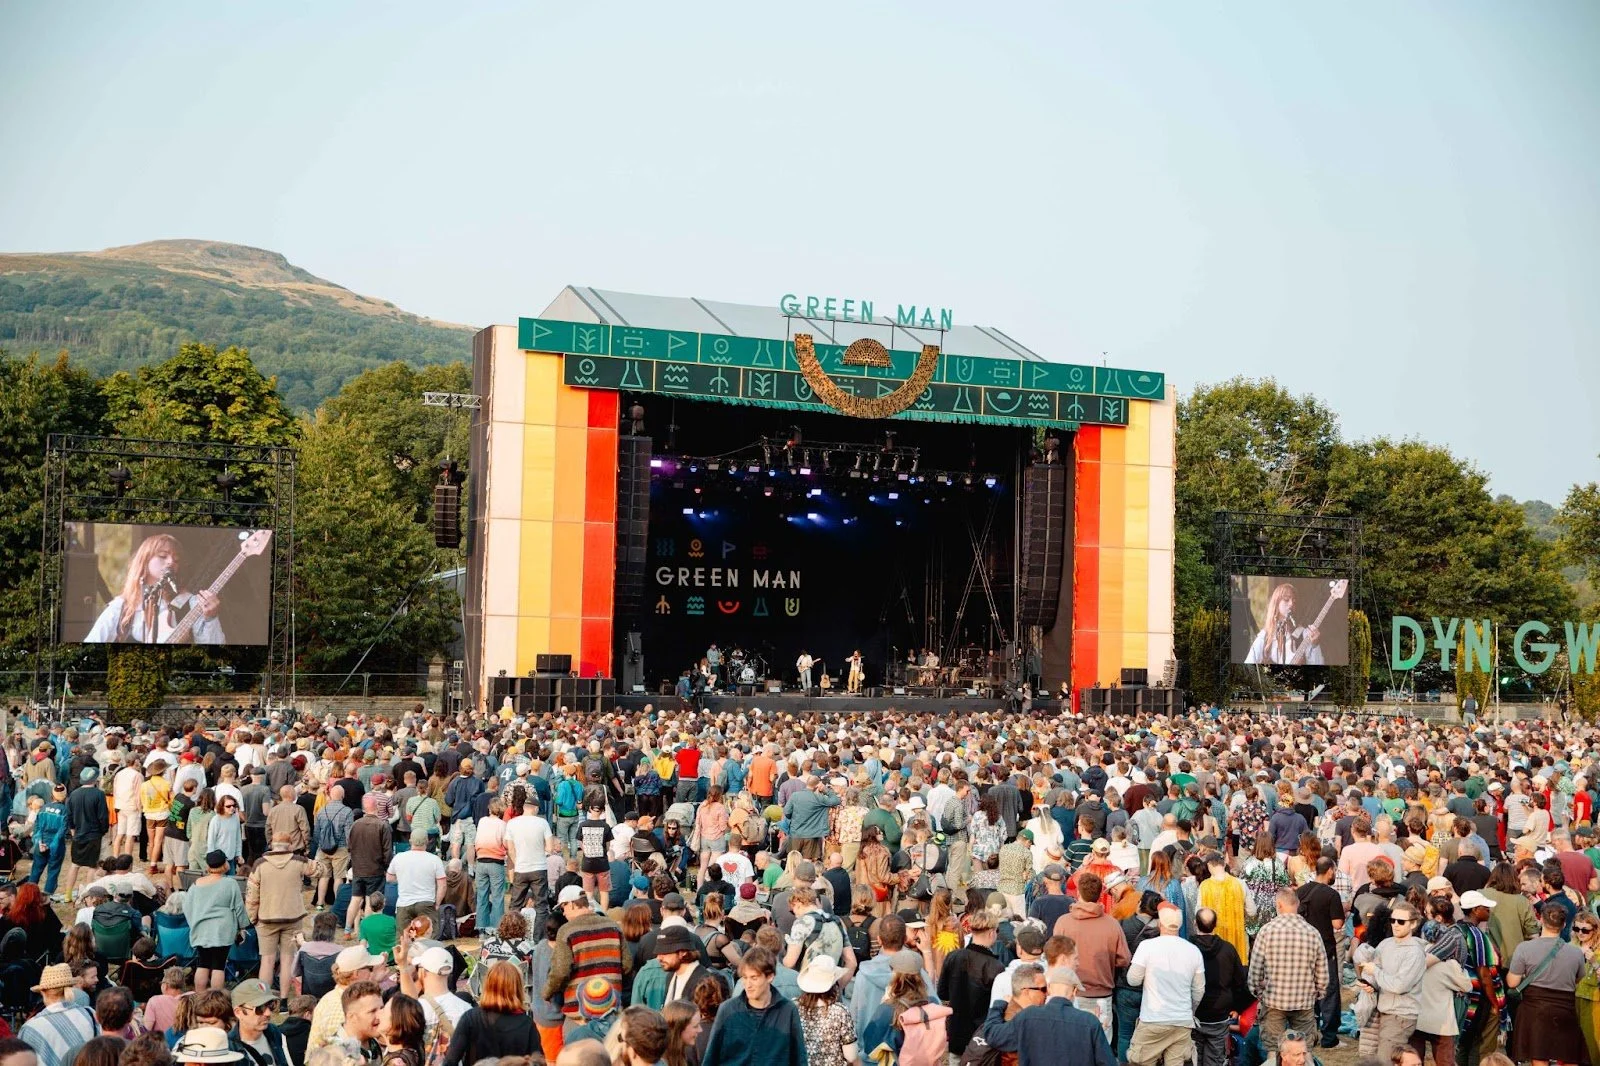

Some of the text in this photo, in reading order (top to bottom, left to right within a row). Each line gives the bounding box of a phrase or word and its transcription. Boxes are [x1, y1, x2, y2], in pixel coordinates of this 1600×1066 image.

[780, 293, 952, 330] GREEN MAN
[655, 566, 801, 589] GREEN MAN
[1391, 615, 1600, 674] DYN GW
